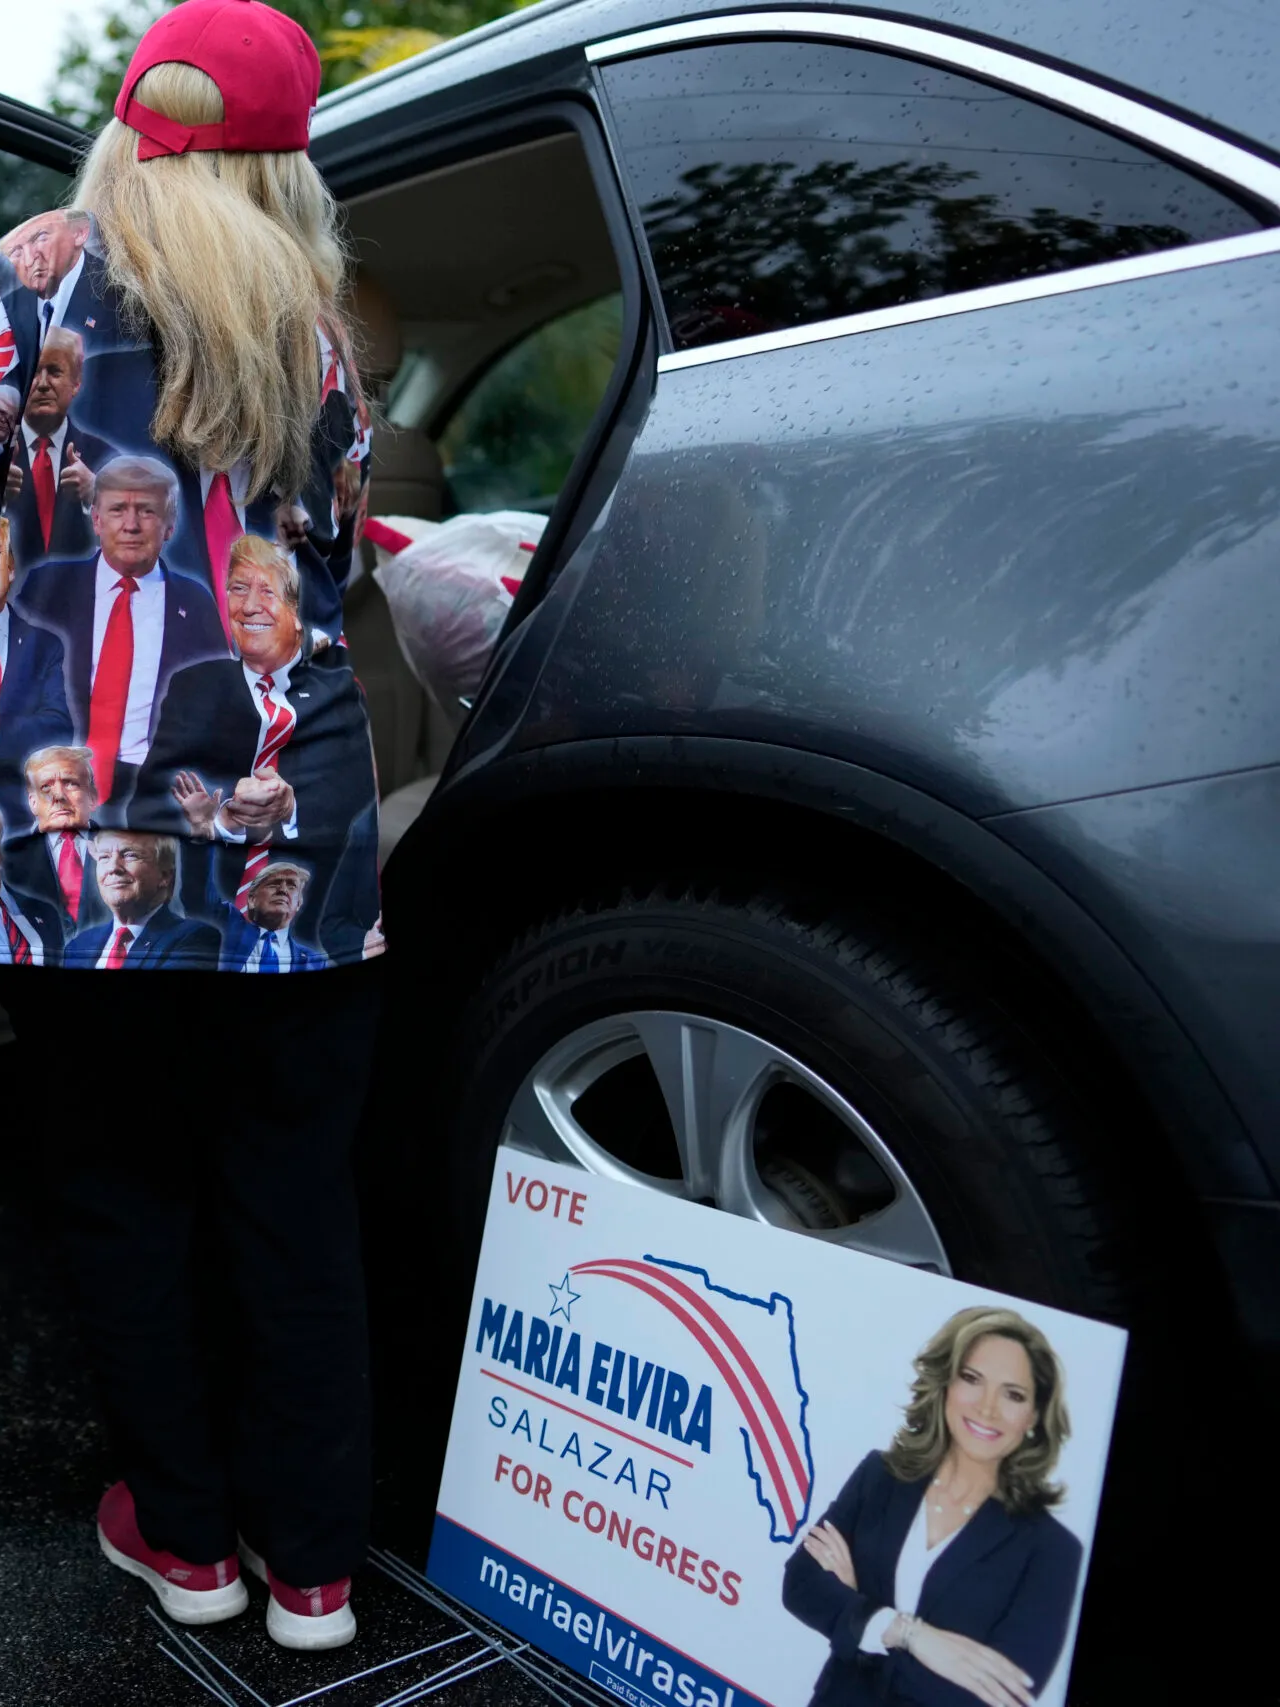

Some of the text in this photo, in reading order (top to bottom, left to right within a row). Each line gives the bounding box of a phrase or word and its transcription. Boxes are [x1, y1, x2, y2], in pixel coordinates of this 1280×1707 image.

[506, 1171, 588, 1227] VOTE
[476, 1297, 713, 1454] MARIA ELVIRA
[488, 1396, 672, 1510] SALAZAR
[494, 1454, 744, 1607] FOR CONGRESS
[606, 1676, 625, 1695] Paid
[625, 1688, 639, 1703] for
